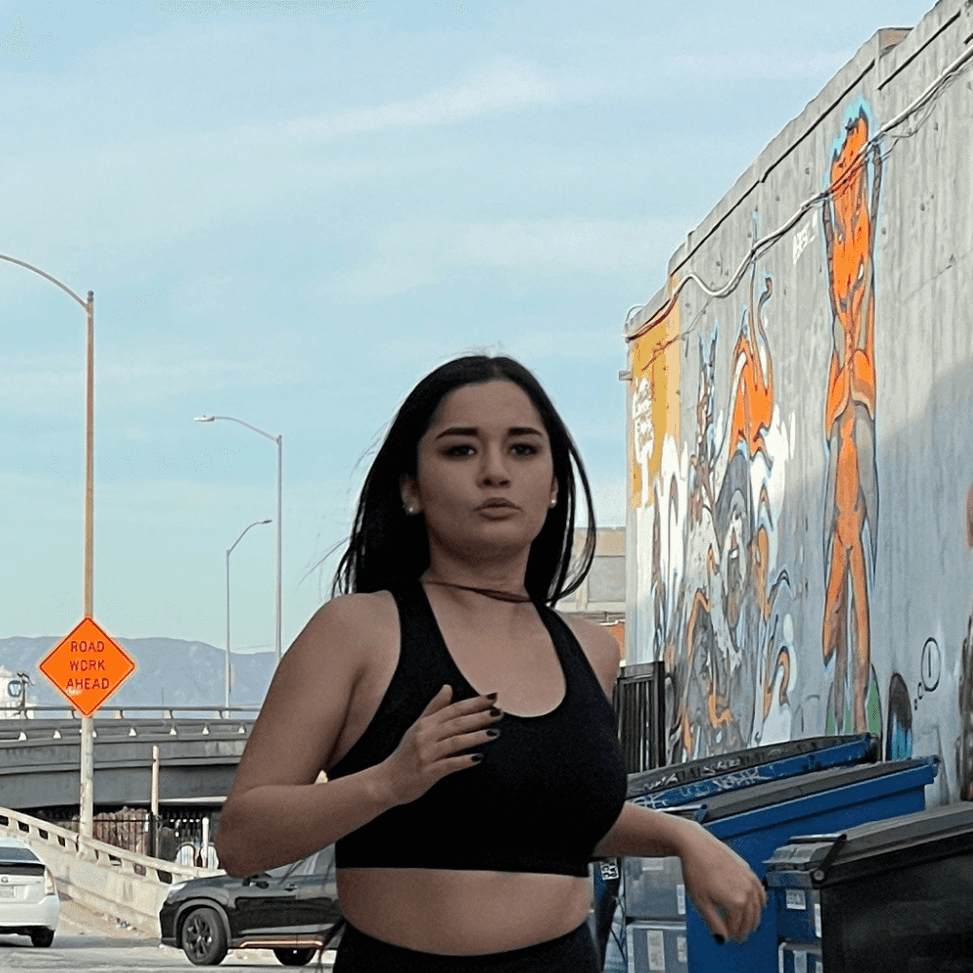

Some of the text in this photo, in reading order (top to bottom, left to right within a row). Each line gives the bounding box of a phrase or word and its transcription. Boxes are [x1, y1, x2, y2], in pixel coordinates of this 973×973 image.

[70, 640, 105, 653] ROAD
[69, 659, 106, 673] WORK
[66, 677, 110, 690] AHEAD
